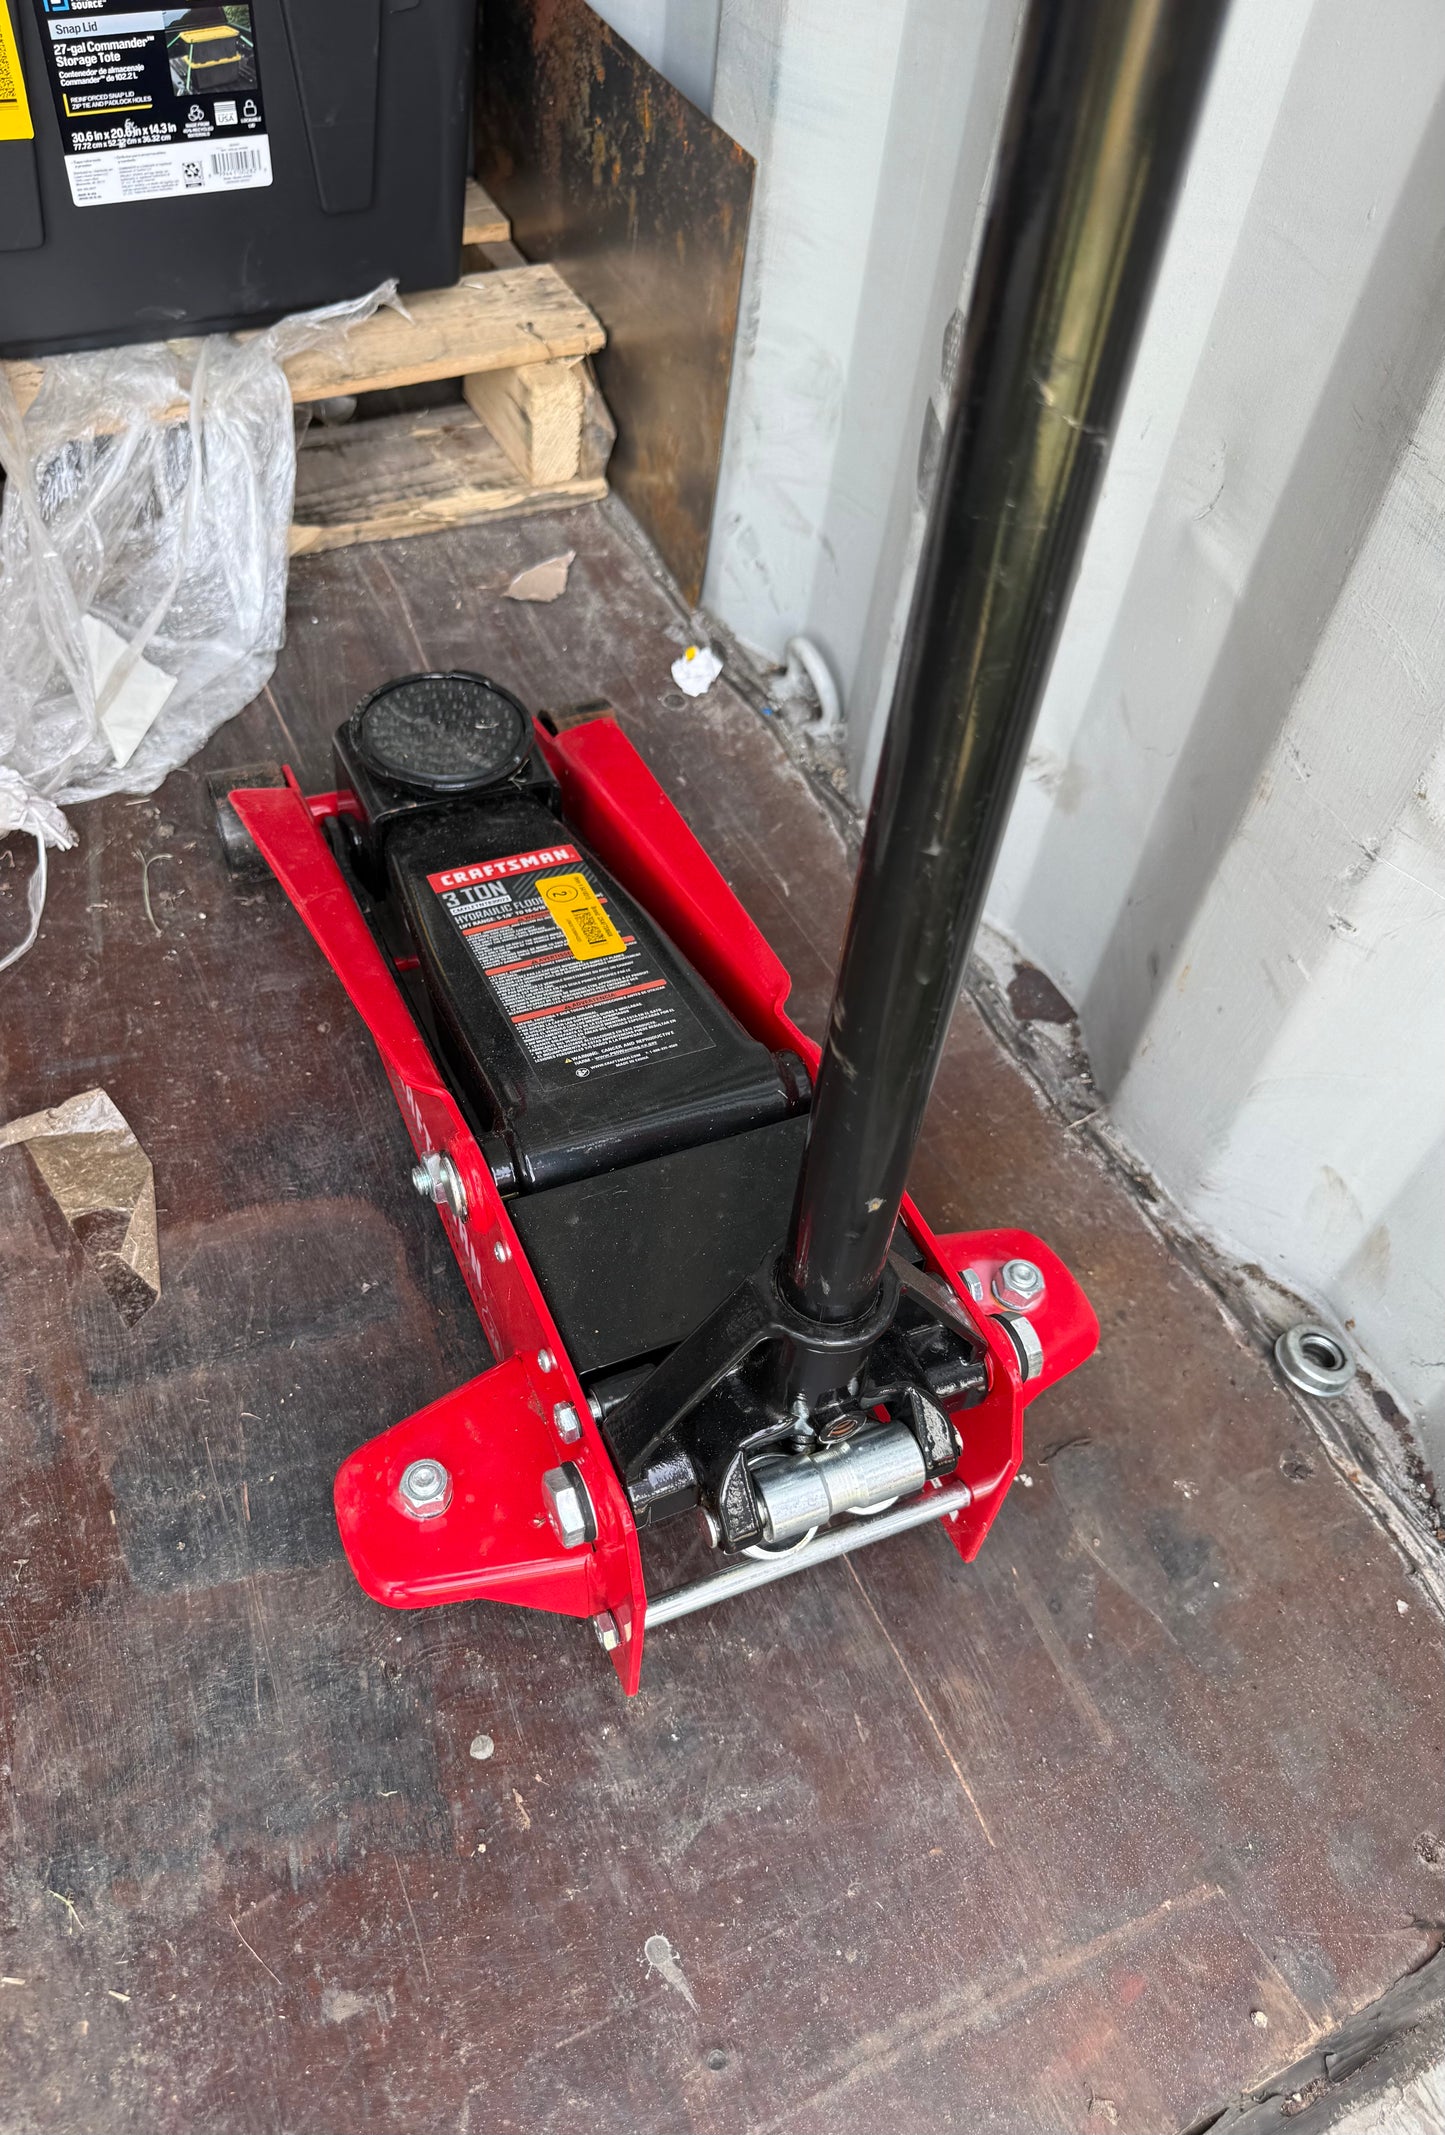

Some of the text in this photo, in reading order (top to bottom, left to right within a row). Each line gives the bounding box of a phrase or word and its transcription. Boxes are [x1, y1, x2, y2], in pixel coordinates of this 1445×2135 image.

[55, 21, 98, 35] Snap Lid
[53, 35, 155, 56] 27-gal Commander™
[55, 52, 121, 67] Storage Tote
[58, 63, 145, 79] Contenedor de almacenaje
[115, 72, 132, 81] 102.2
[70, 90, 135, 104] REINFORCED SNAP LID
[72, 102, 82, 110] ZIP
[92, 99, 104, 108] AND
[104, 97, 132, 107] PADLOCK
[132, 95, 153, 104] HOLES
[218, 115, 235, 123] USA
[71, 132, 94, 143] 30.6
[94, 131, 103, 141] in
[103, 131, 110, 139] x
[142, 127, 149, 135] x
[149, 123, 167, 134] 14.3
[168, 122, 177, 132] in
[92, 141, 103, 149] cm
[440, 848, 571, 887] CRAFTSMAN
[442, 880, 508, 909] 3 TON
[454, 904, 513, 924] HYDRAULIC
[539, 950, 574, 962] AVERTISSE
